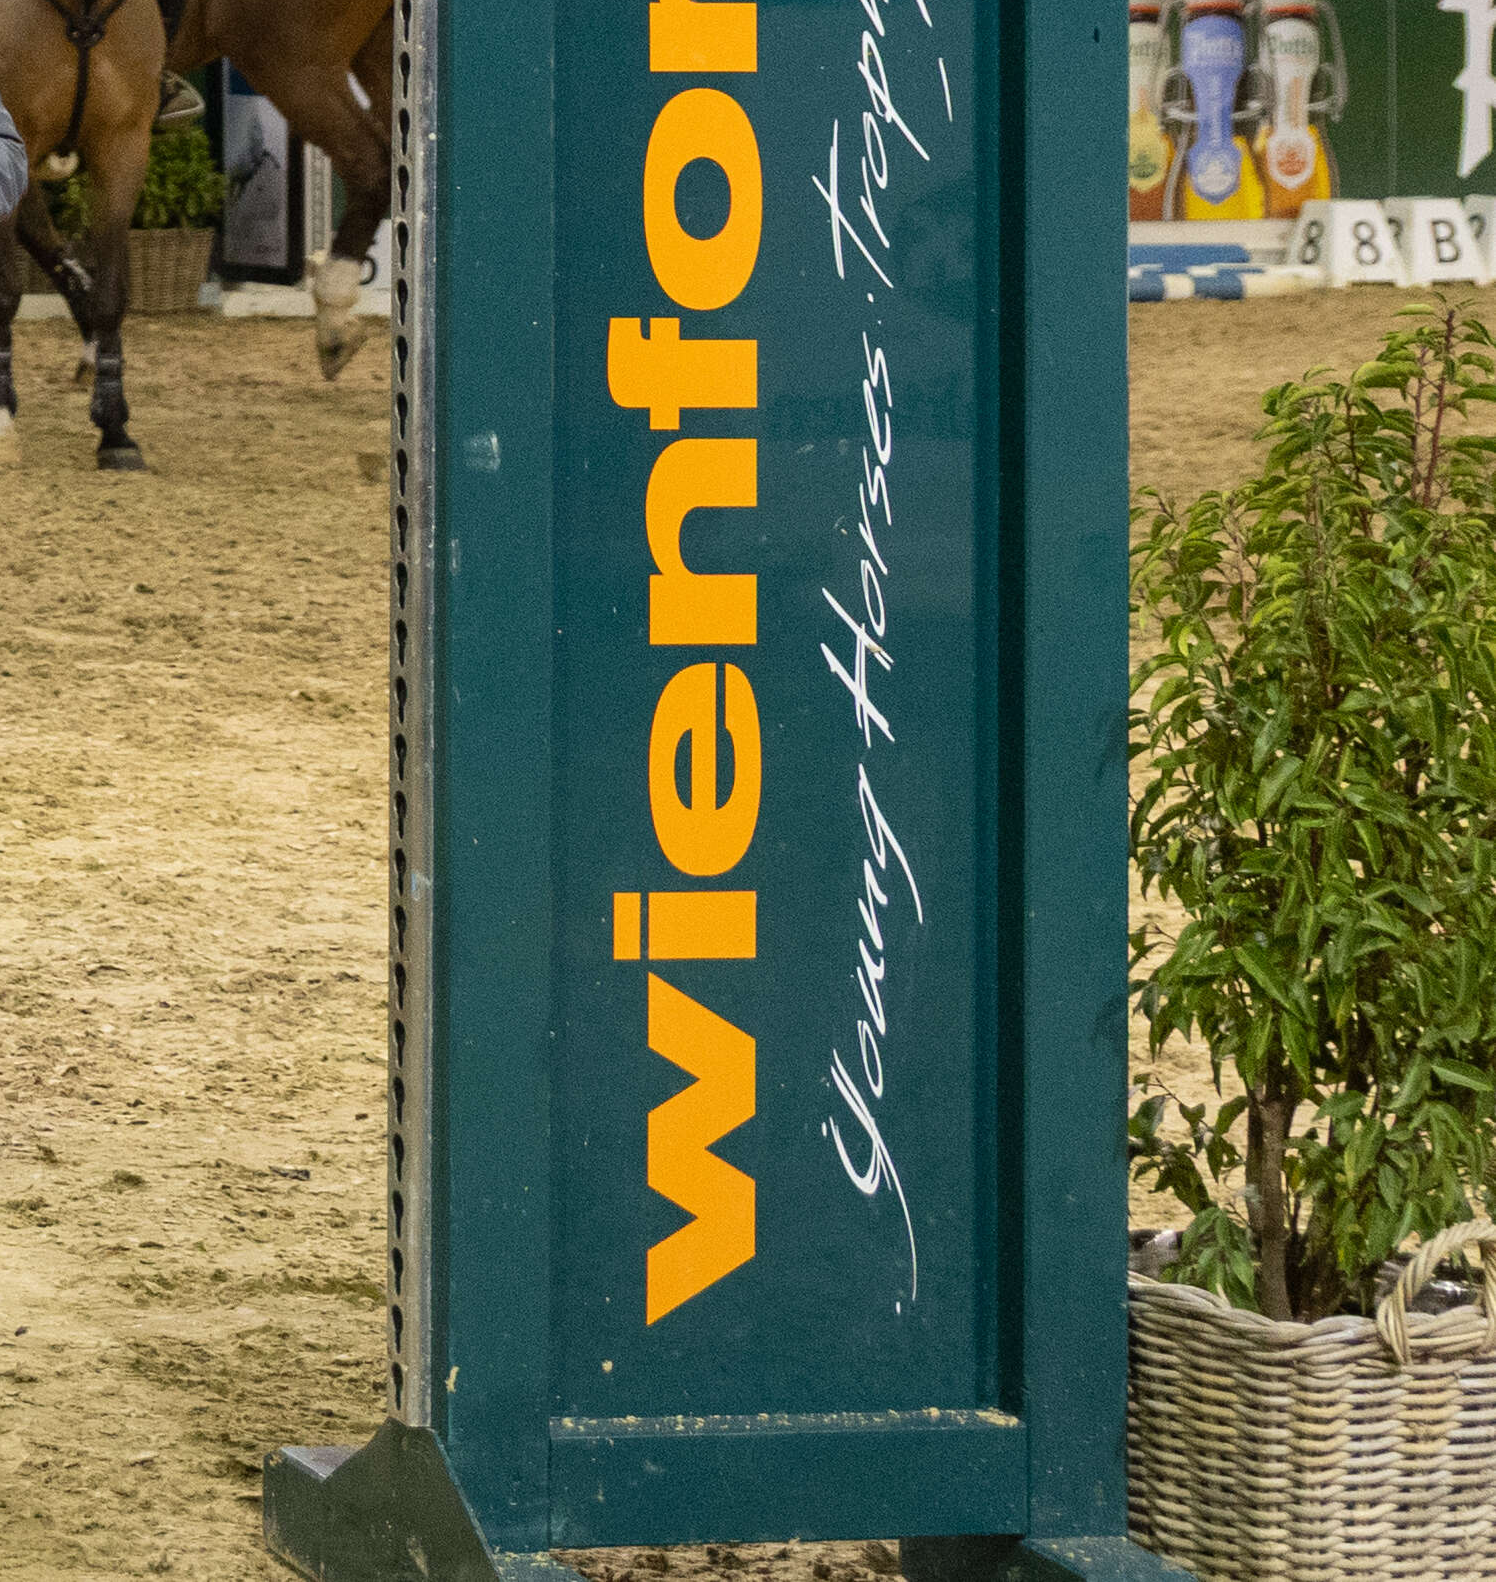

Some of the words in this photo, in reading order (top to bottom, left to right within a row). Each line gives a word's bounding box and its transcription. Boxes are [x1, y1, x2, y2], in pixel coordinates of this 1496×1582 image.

[1353, 220, 1381, 266] 8
[821, 333, 897, 745] Horses
[822, 763, 924, 1302] Young
